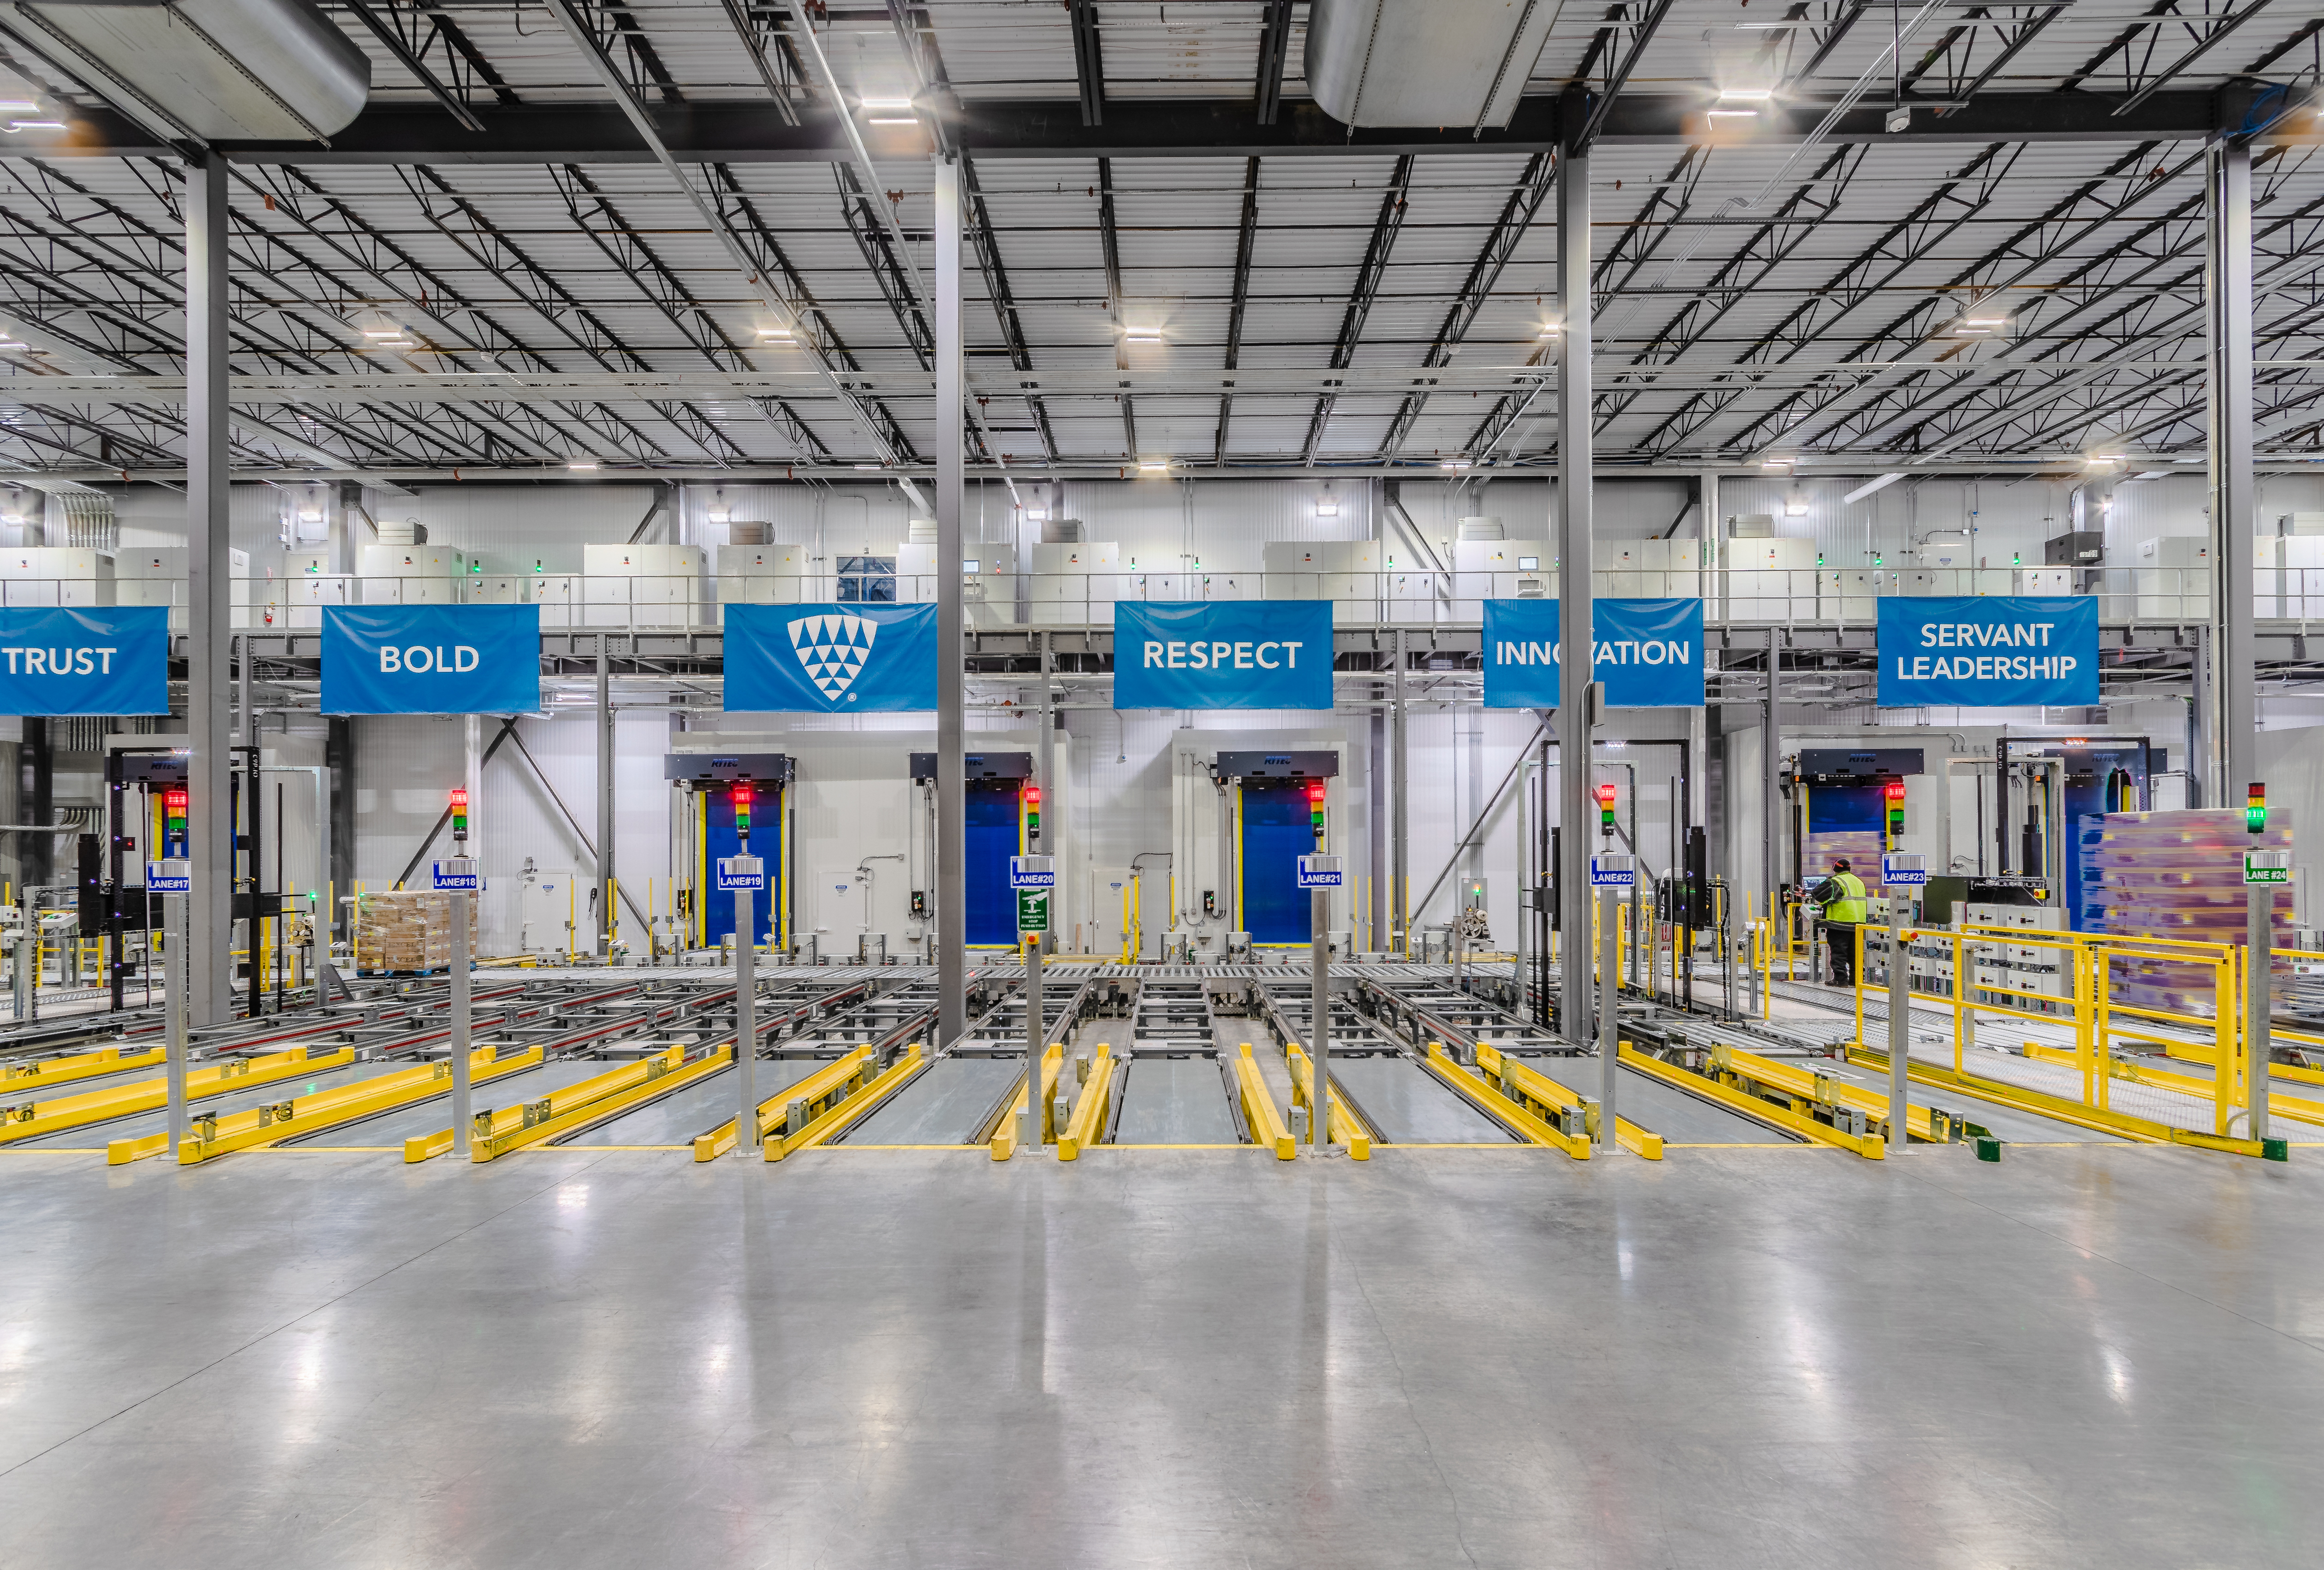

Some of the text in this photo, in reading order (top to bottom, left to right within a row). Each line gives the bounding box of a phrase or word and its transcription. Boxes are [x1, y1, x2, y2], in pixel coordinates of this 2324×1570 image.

[1921, 624, 2054, 647] SERVANT
[1144, 642, 1302, 668] RESPECT
[1497, 641, 1688, 665] INNATION
[1, 648, 117, 674] TRUST
[381, 646, 479, 672] BOLD
[1898, 656, 2076, 679] LEADERSHIP
[1264, 756, 1291, 765] RYTEC
[1848, 754, 1876, 762] RYTEC
[711, 759, 738, 767] RYTEC
[1013, 875, 1053, 883] LANE#20
[1301, 874, 1340, 883] LANE#21
[1592, 874, 1633, 882] LANE#22
[2246, 871, 2286, 879] LANE #24
[149, 880, 188, 888] LANE#17
[435, 878, 476, 886] LANE#18
[721, 877, 761, 886] LANE#19
